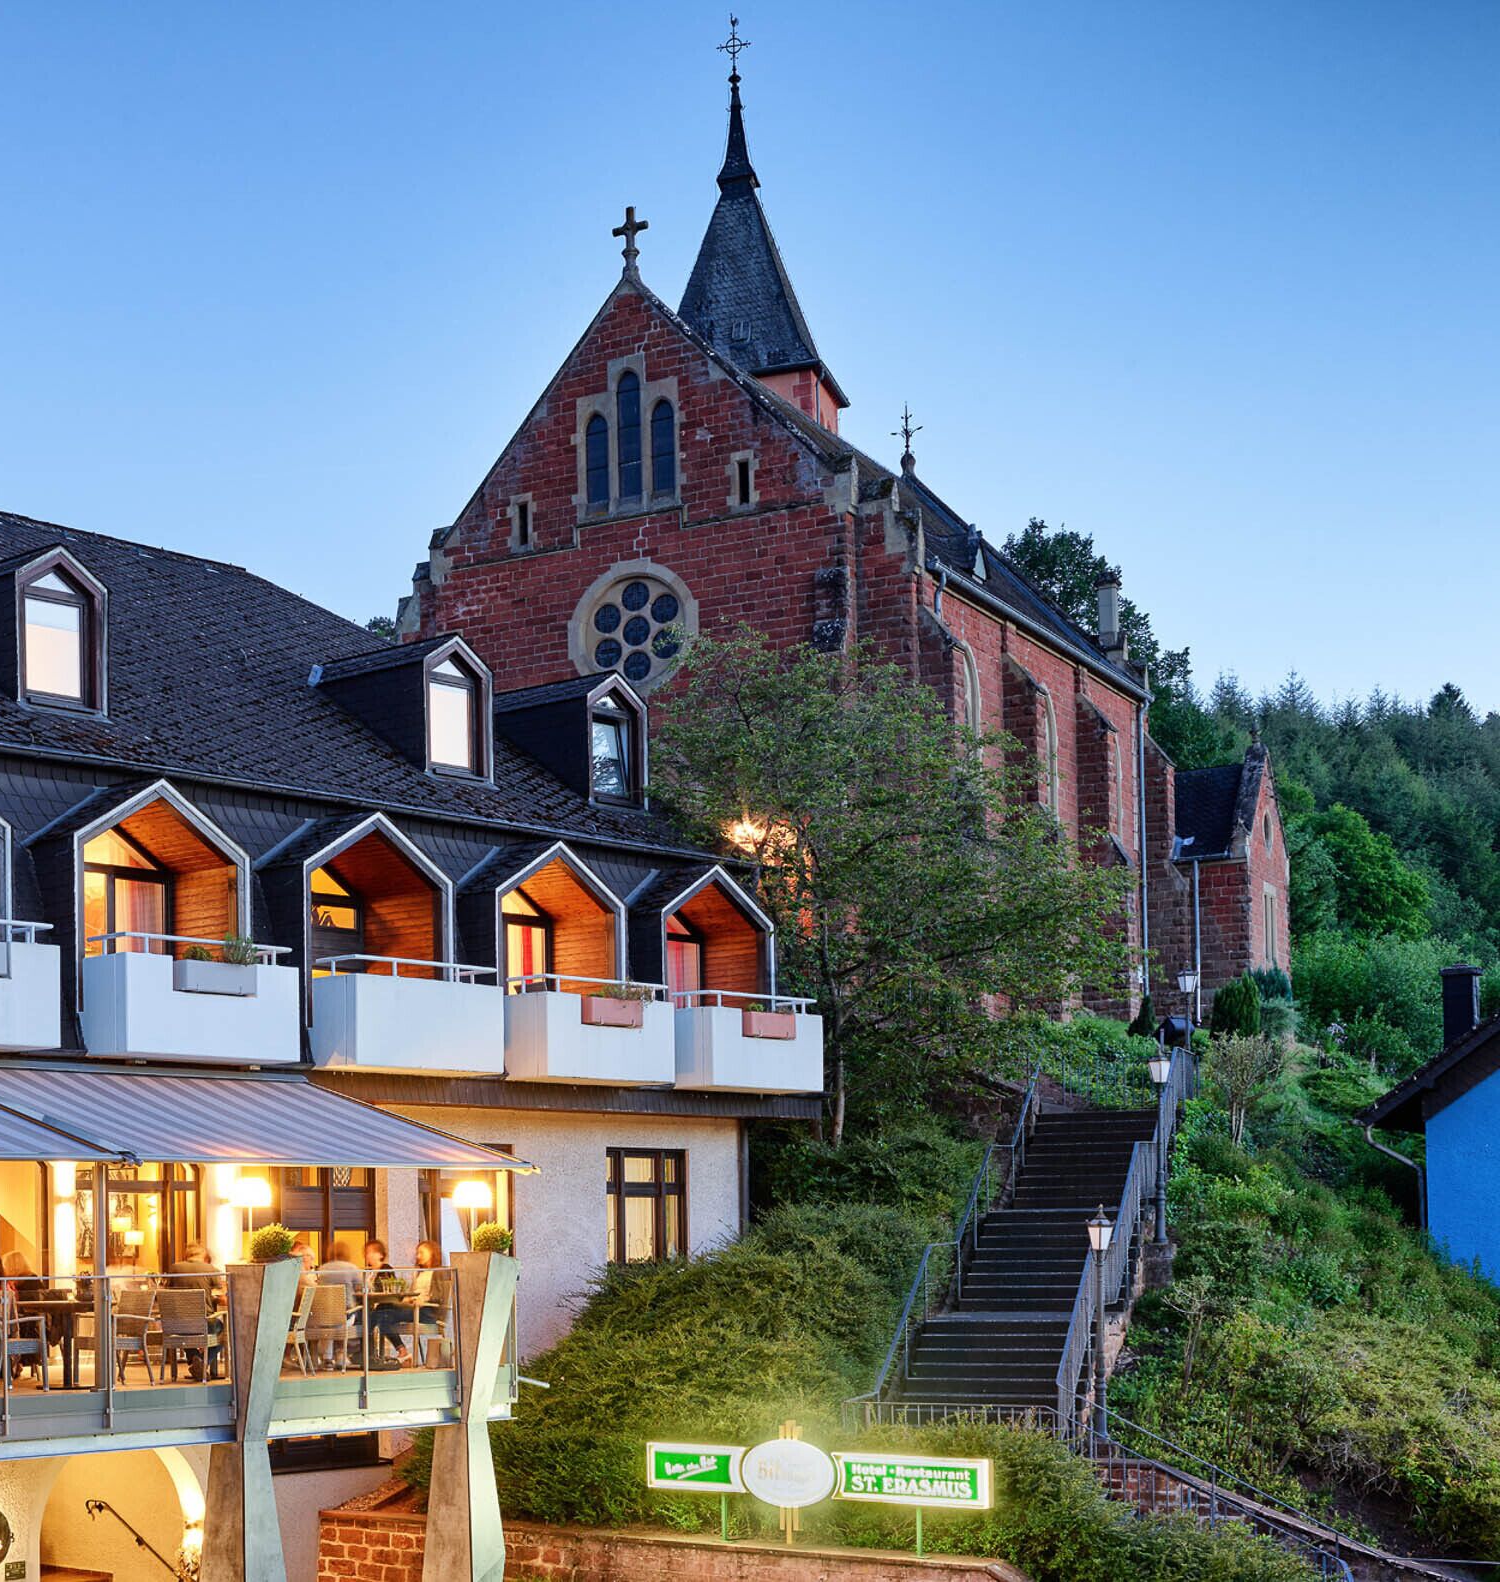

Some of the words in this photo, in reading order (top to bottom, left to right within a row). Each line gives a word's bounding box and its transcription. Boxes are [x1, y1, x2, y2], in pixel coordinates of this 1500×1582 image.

[851, 1463, 887, 1476] Hotel
[896, 1466, 971, 1481] Restaurant
[851, 1476, 879, 1493] ST.
[882, 1477, 973, 1499] ERASMUS
